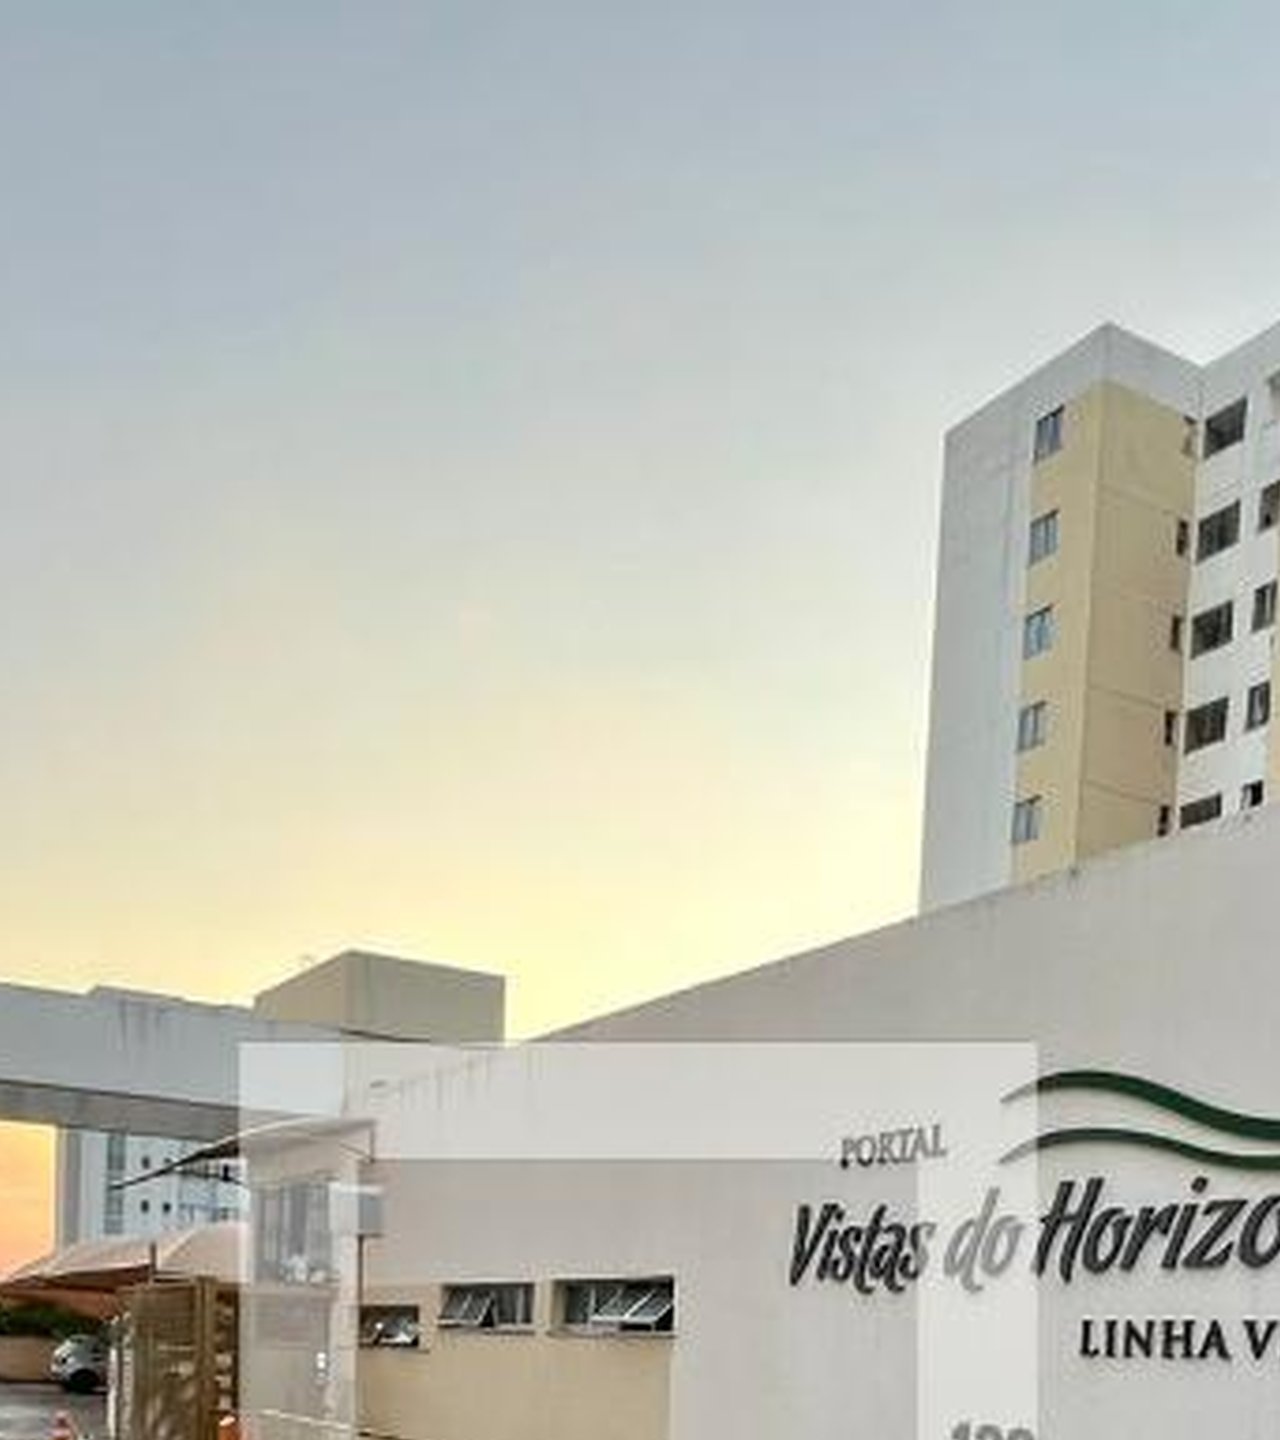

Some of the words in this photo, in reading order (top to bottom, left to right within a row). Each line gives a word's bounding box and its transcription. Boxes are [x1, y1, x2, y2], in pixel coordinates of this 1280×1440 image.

[839, 1124, 947, 1168] PORTAL
[790, 1202, 930, 1293] Vistas
[942, 1187, 1021, 1291] do
[1079, 1318, 1232, 1361] LINHA
